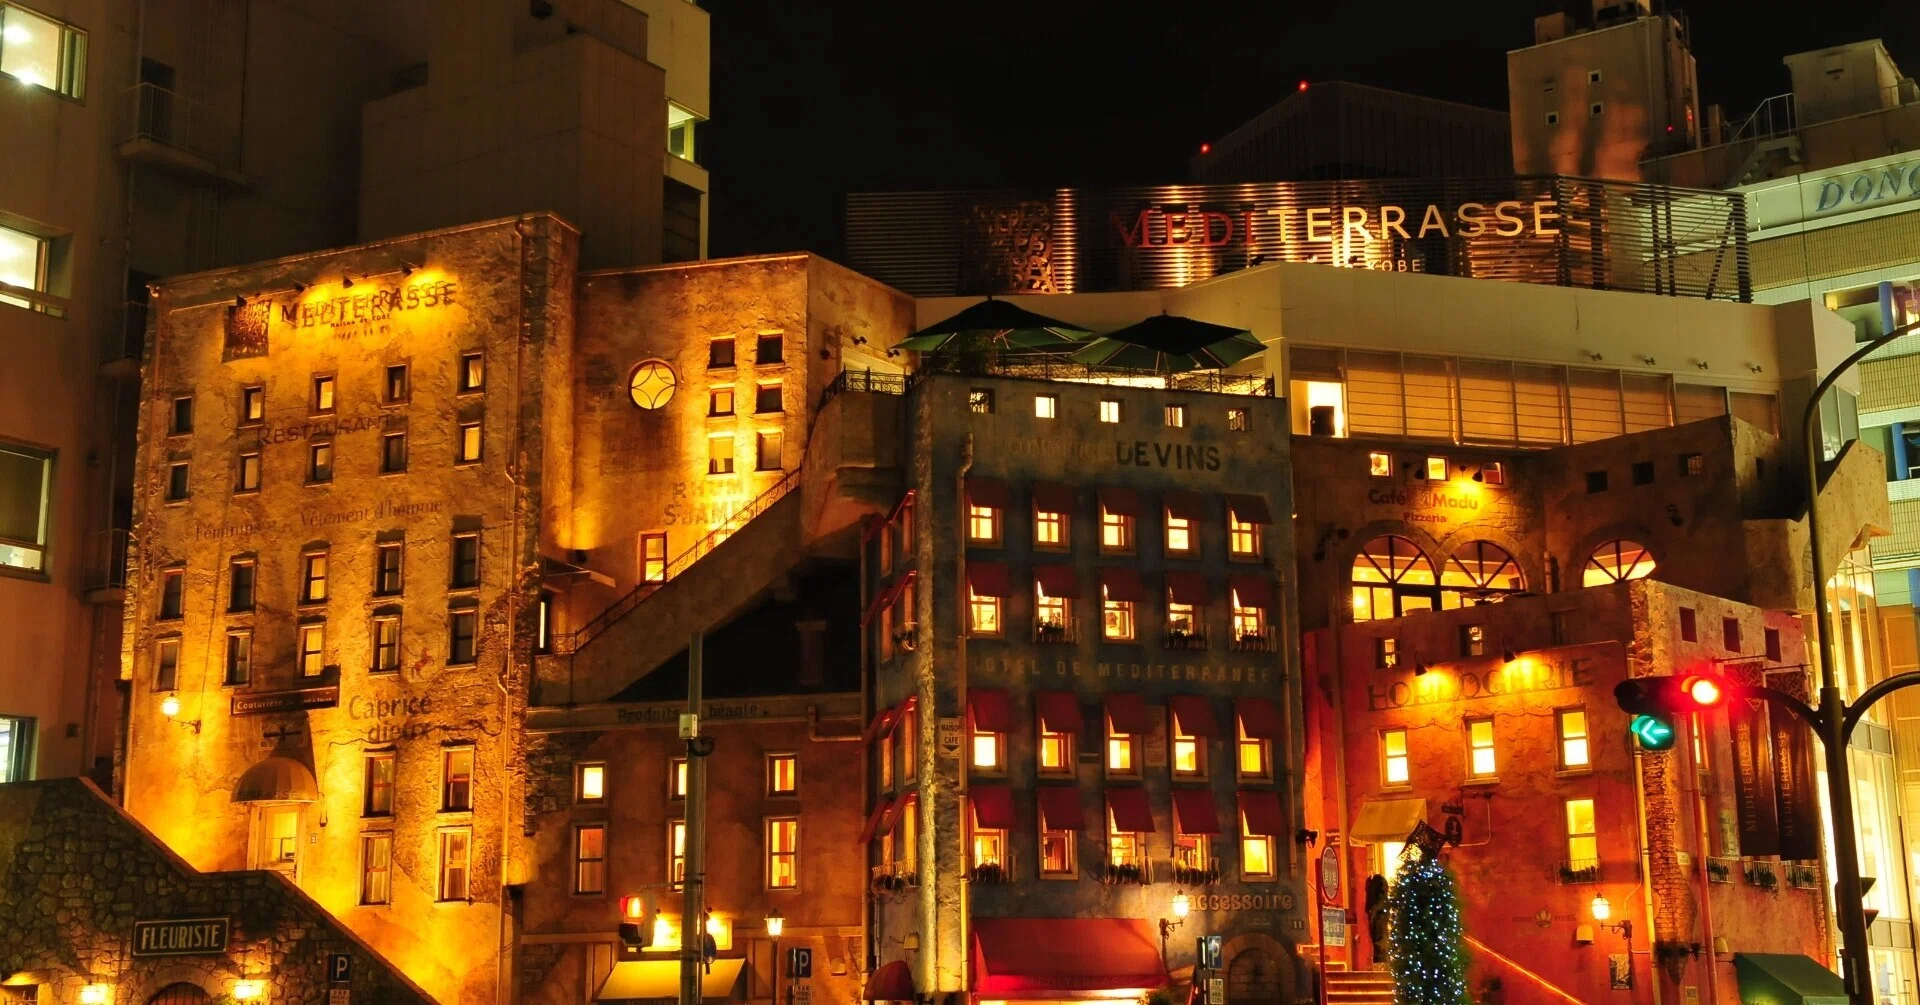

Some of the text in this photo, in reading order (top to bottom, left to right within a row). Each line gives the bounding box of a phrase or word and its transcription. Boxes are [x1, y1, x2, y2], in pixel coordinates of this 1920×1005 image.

[1109, 200, 1562, 249] MEDITERRASSE
[281, 281, 457, 323] MEDITERRASSE
[257, 414, 391, 445] RESTAURANT
[1367, 487, 1479, 511] Café Madu
[1402, 511, 1447, 524] Pizzeria
[348, 694, 433, 721] Caprice
[140, 924, 220, 950] FLEURISTE
[799, 951, 810, 975] P
[1211, 940, 1220, 966] P
[336, 957, 348, 978] P
